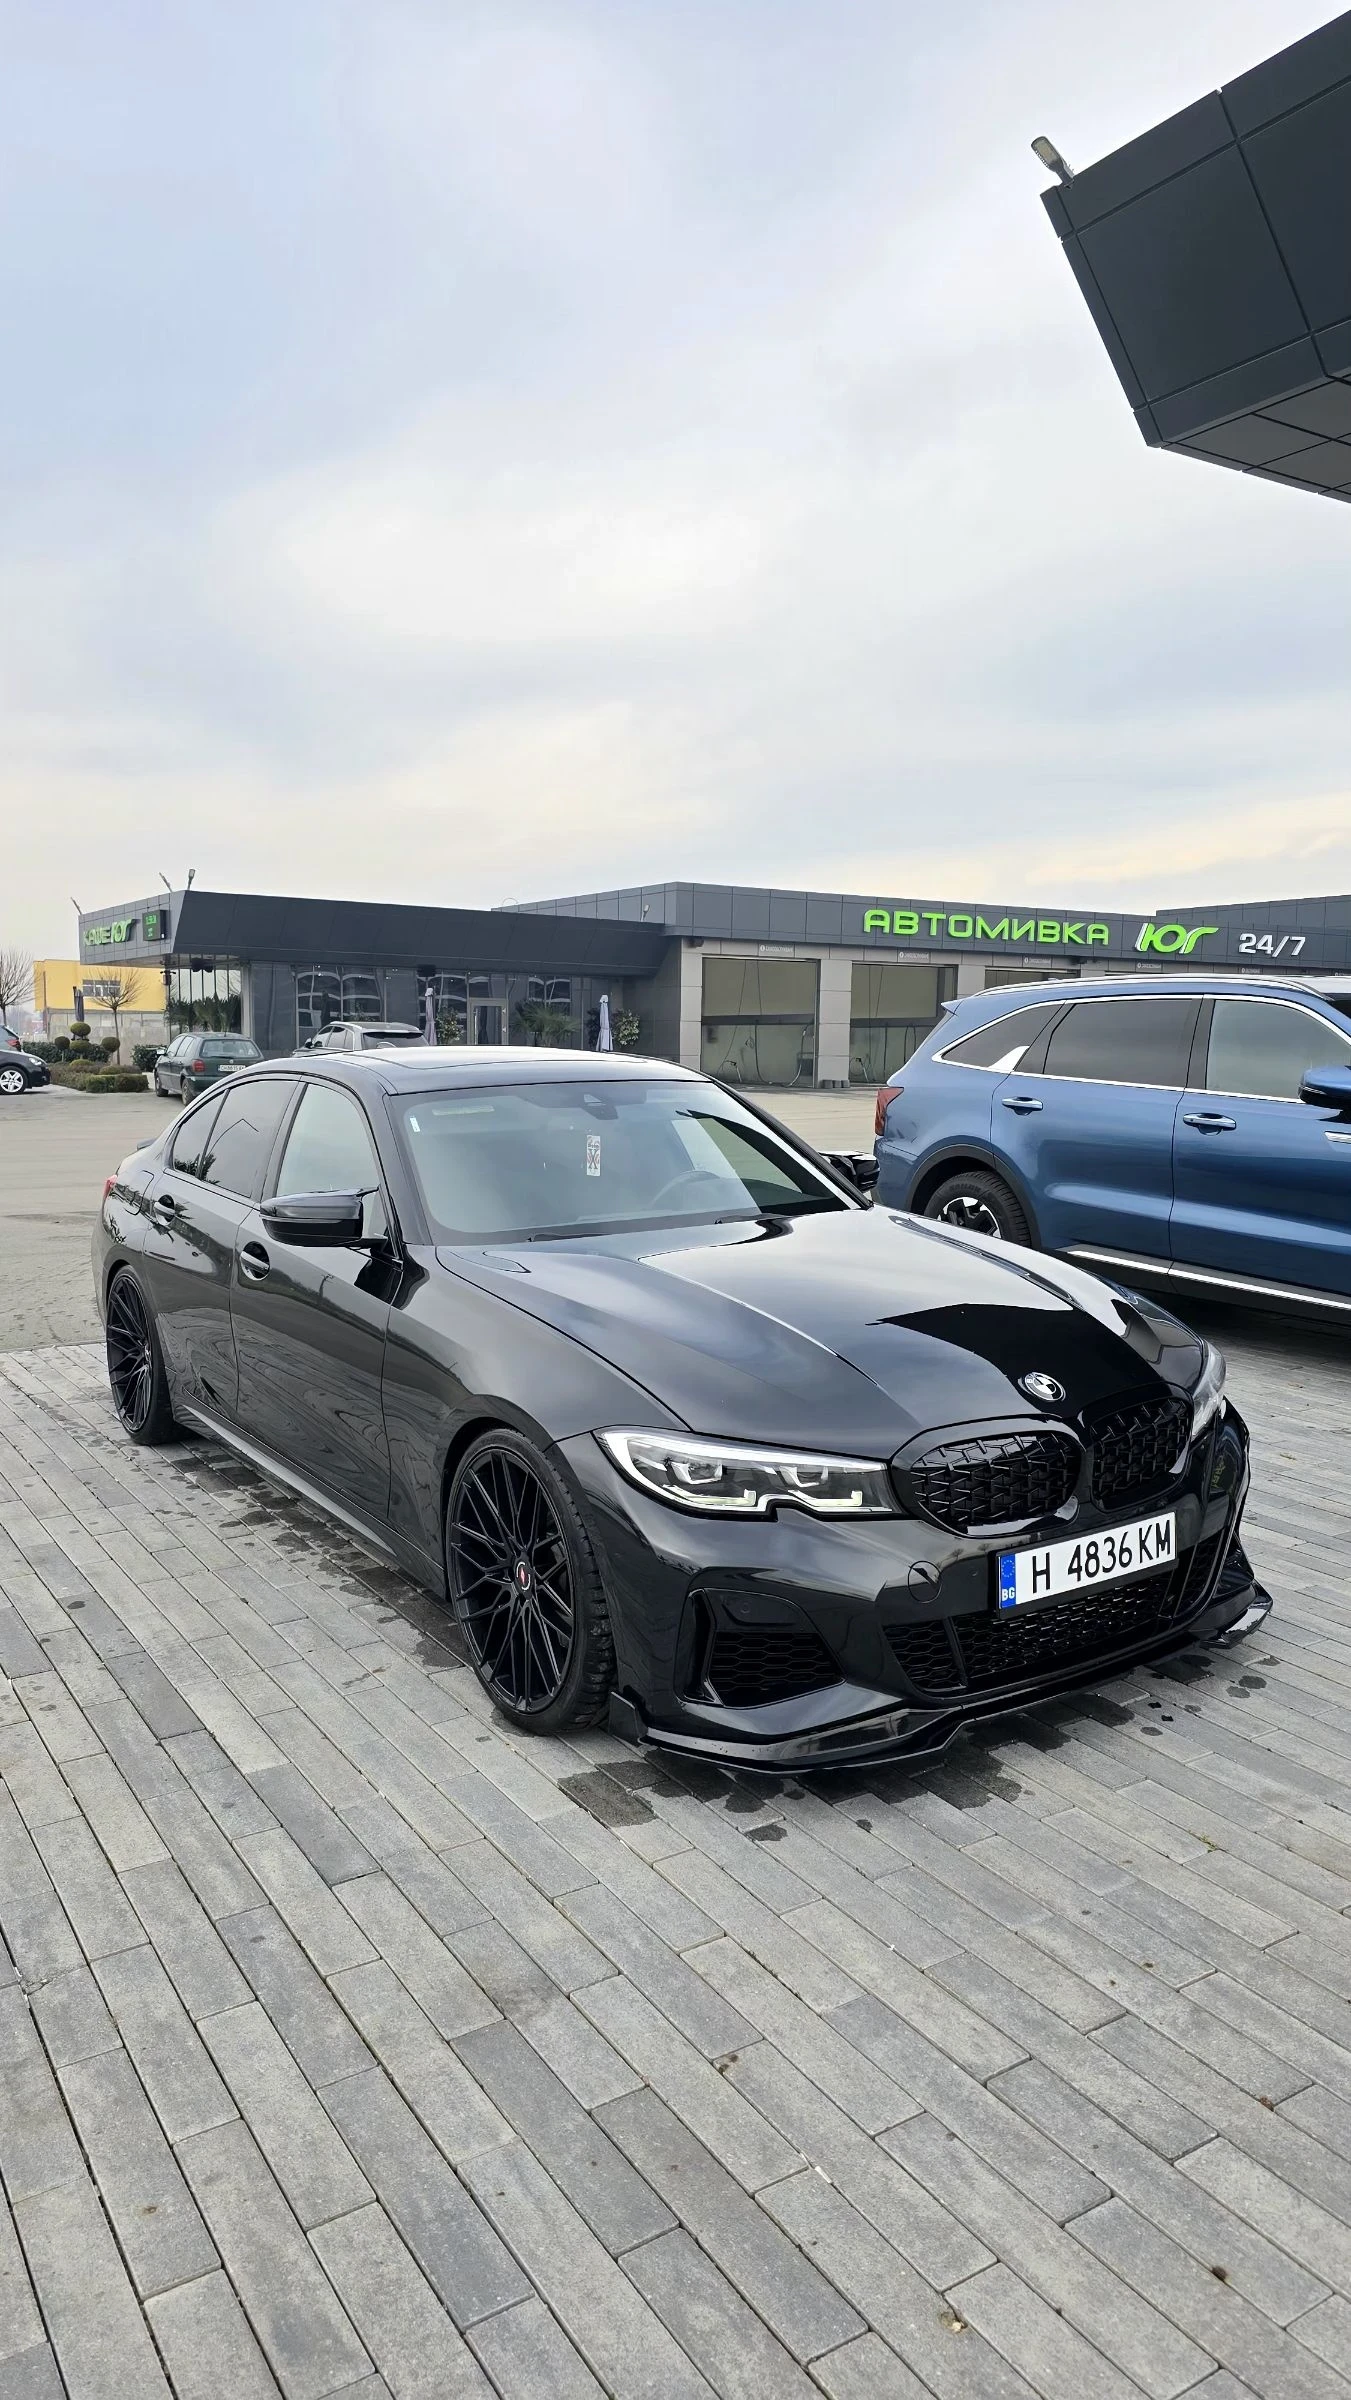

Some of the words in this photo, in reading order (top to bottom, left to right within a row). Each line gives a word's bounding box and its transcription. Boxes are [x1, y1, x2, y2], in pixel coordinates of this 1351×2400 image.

[863, 908, 1110, 946] АВТОМИВКА
[1238, 933, 1307, 958] 24/7
[1032, 1551, 1051, 1594] H
[1067, 1531, 1133, 1582] 4836
[1138, 1519, 1171, 1564] KM
[1001, 1588, 1016, 1601] BG
